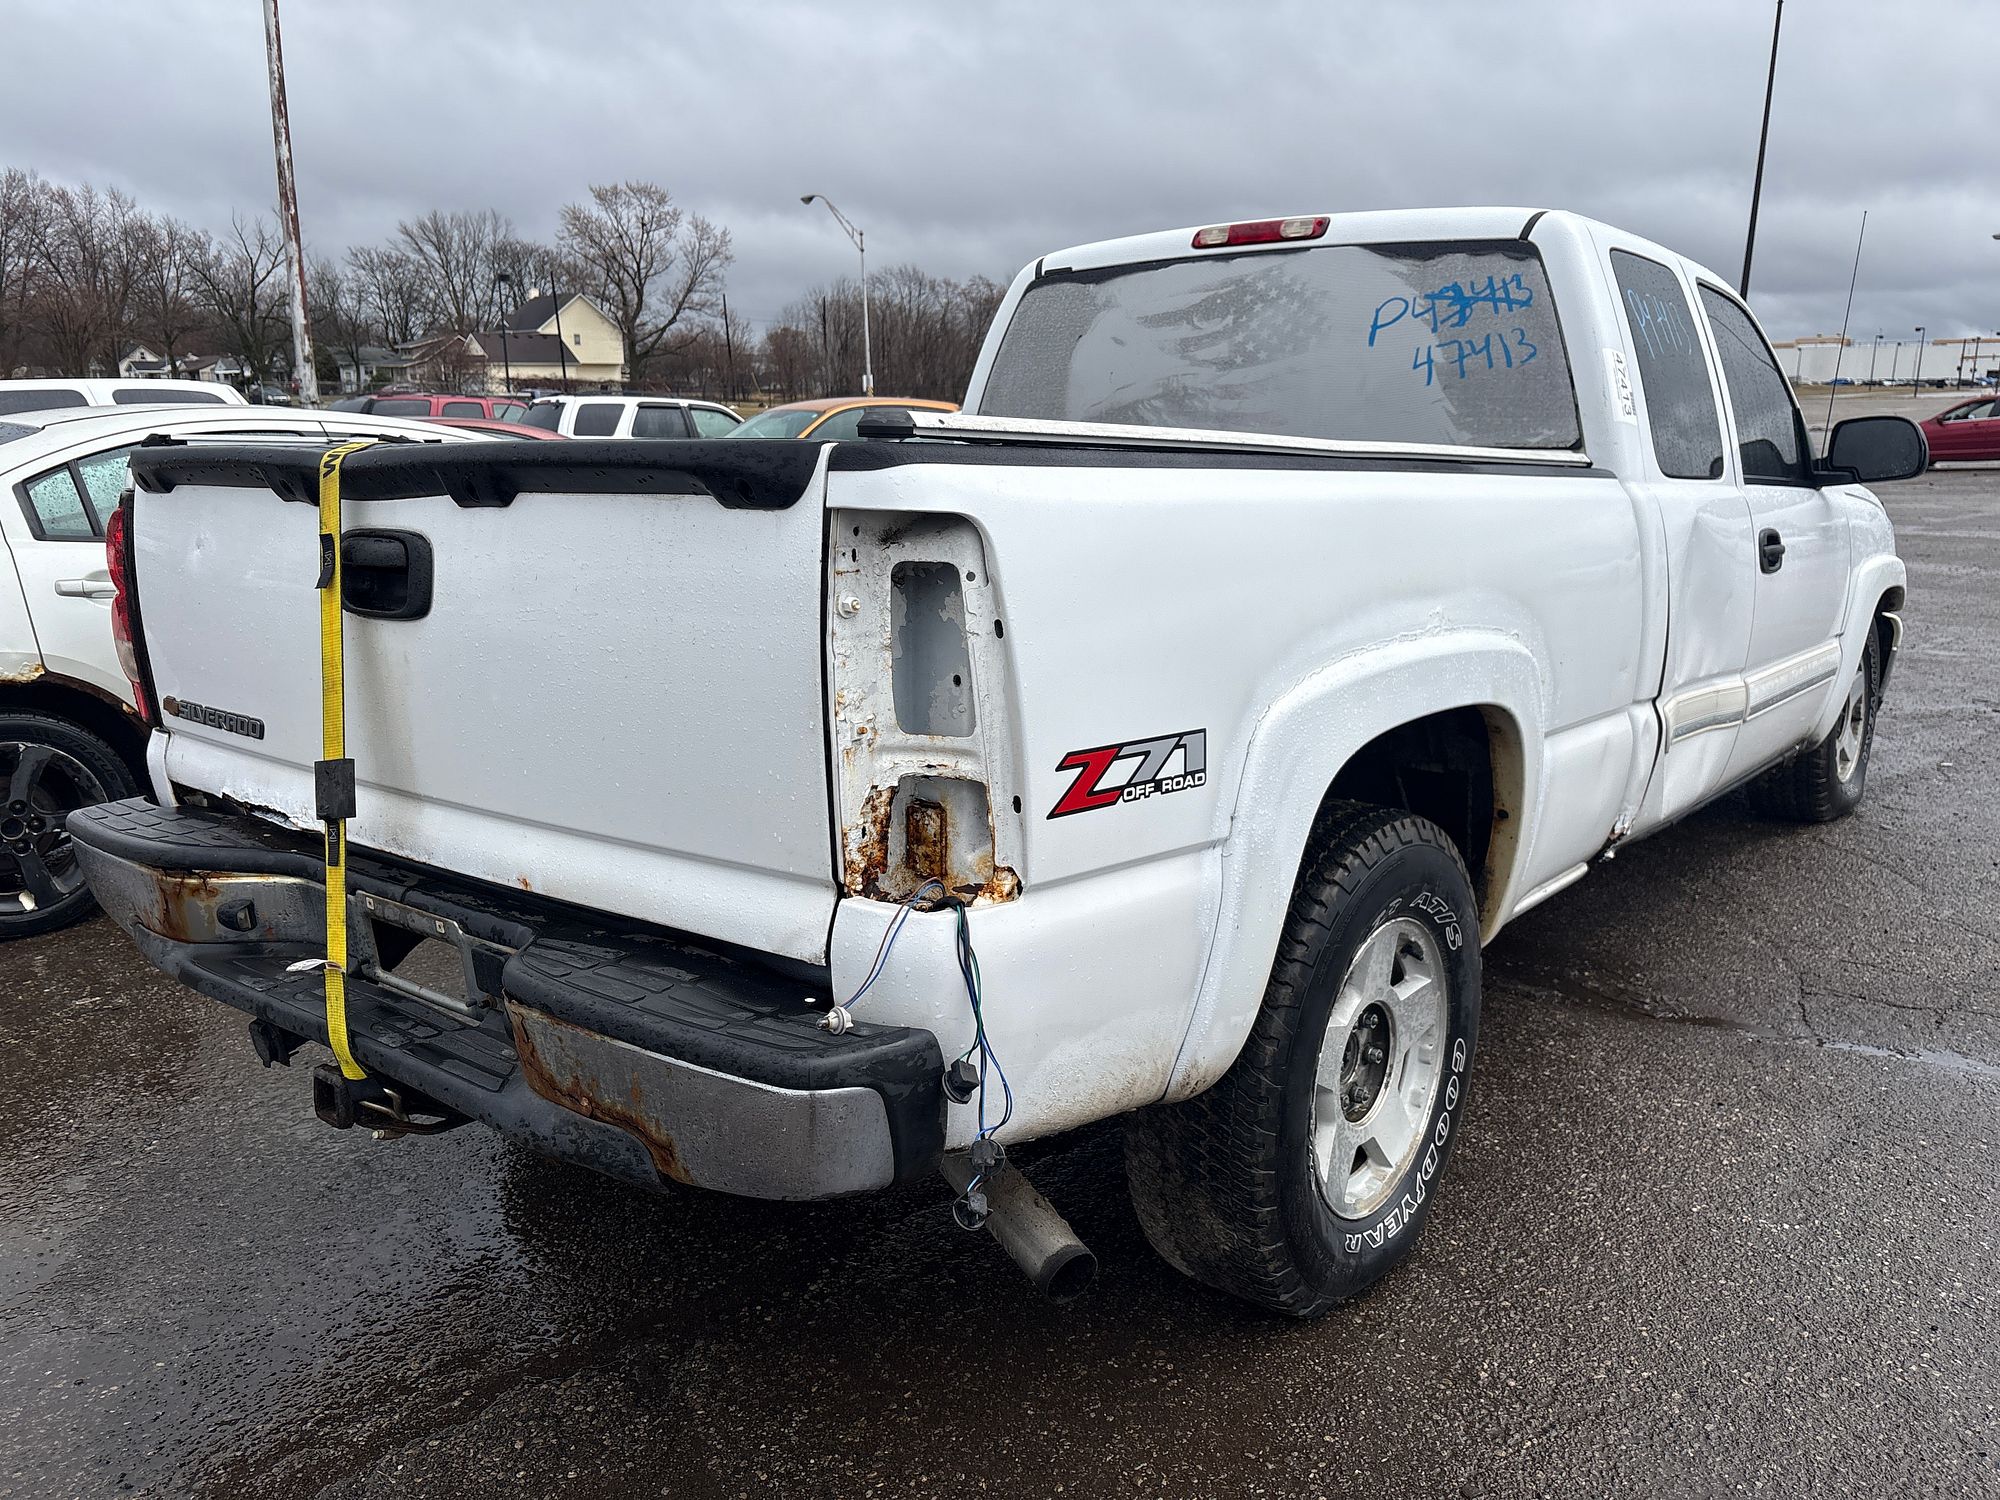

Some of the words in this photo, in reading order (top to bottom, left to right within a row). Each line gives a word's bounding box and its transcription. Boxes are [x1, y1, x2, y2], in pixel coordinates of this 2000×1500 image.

[1412, 328, 1537, 386] 47413
[1615, 352, 1633, 416] 47413
[178, 700, 264, 740] SILVERADO
[1046, 728, 1207, 820] Z71
[1123, 782, 1155, 801] OFF
[1161, 772, 1206, 793] ROAD
[1345, 1037, 1466, 1253] GOODYEAR
